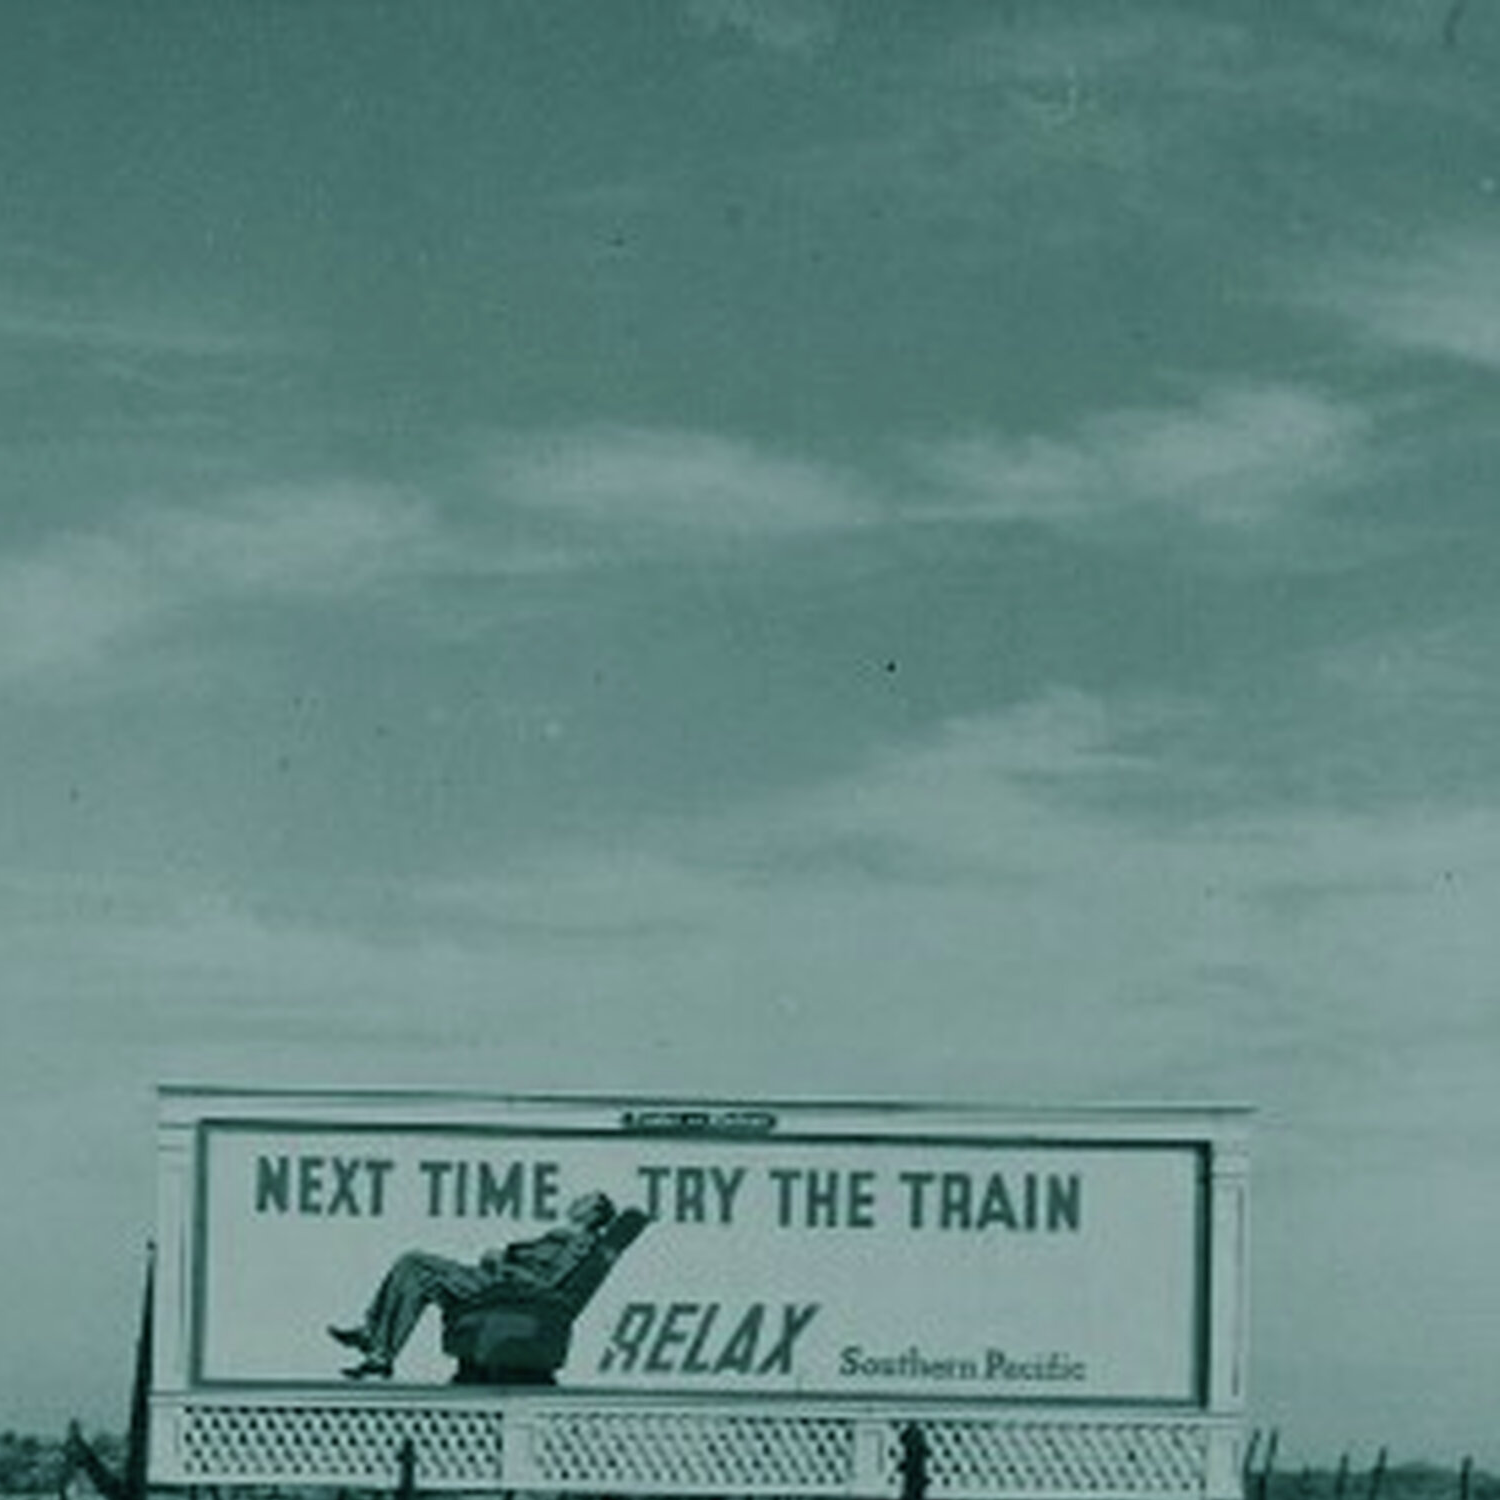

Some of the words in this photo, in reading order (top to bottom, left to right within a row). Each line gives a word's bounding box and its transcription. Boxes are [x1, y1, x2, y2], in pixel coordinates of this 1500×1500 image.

[255, 1156, 394, 1217] NEXT
[419, 1160, 558, 1221] TIME
[637, 1166, 746, 1225] TRY
[769, 1169, 876, 1229] THE
[900, 1171, 1082, 1231] TRAIN
[600, 1302, 820, 1375] RELAX
[838, 1346, 978, 1379] Southern
[985, 1347, 1087, 1382] Pacific
